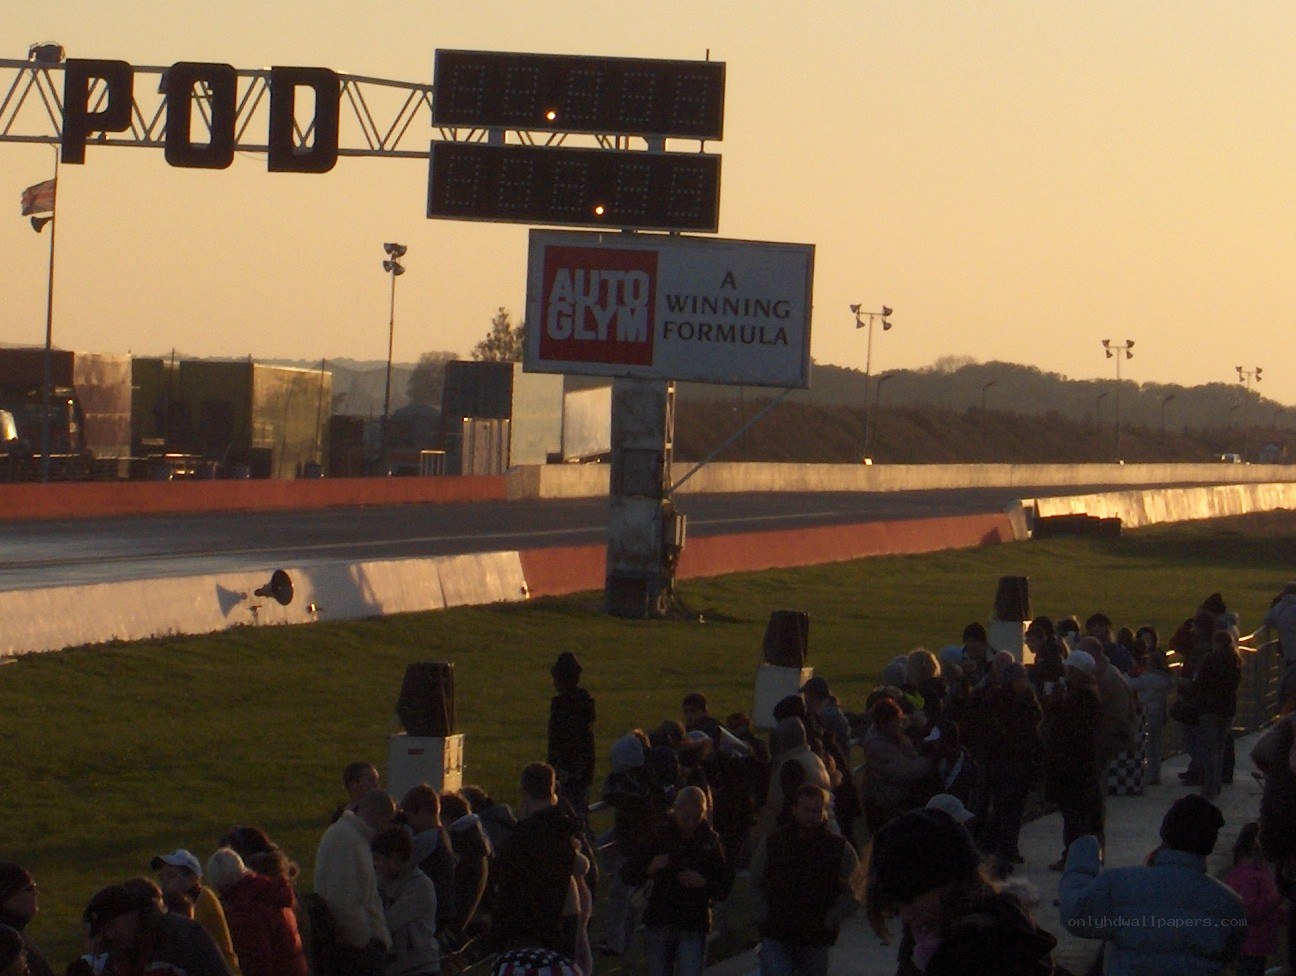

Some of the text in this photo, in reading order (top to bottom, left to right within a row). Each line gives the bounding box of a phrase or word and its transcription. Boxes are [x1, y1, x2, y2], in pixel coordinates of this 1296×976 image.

[61, 57, 340, 174] POD
[549, 267, 650, 303] AUTO
[720, 271, 737, 289] A
[666, 294, 791, 319] WINNING
[547, 301, 648, 343] GLYM
[663, 321, 789, 345] FORMULA
